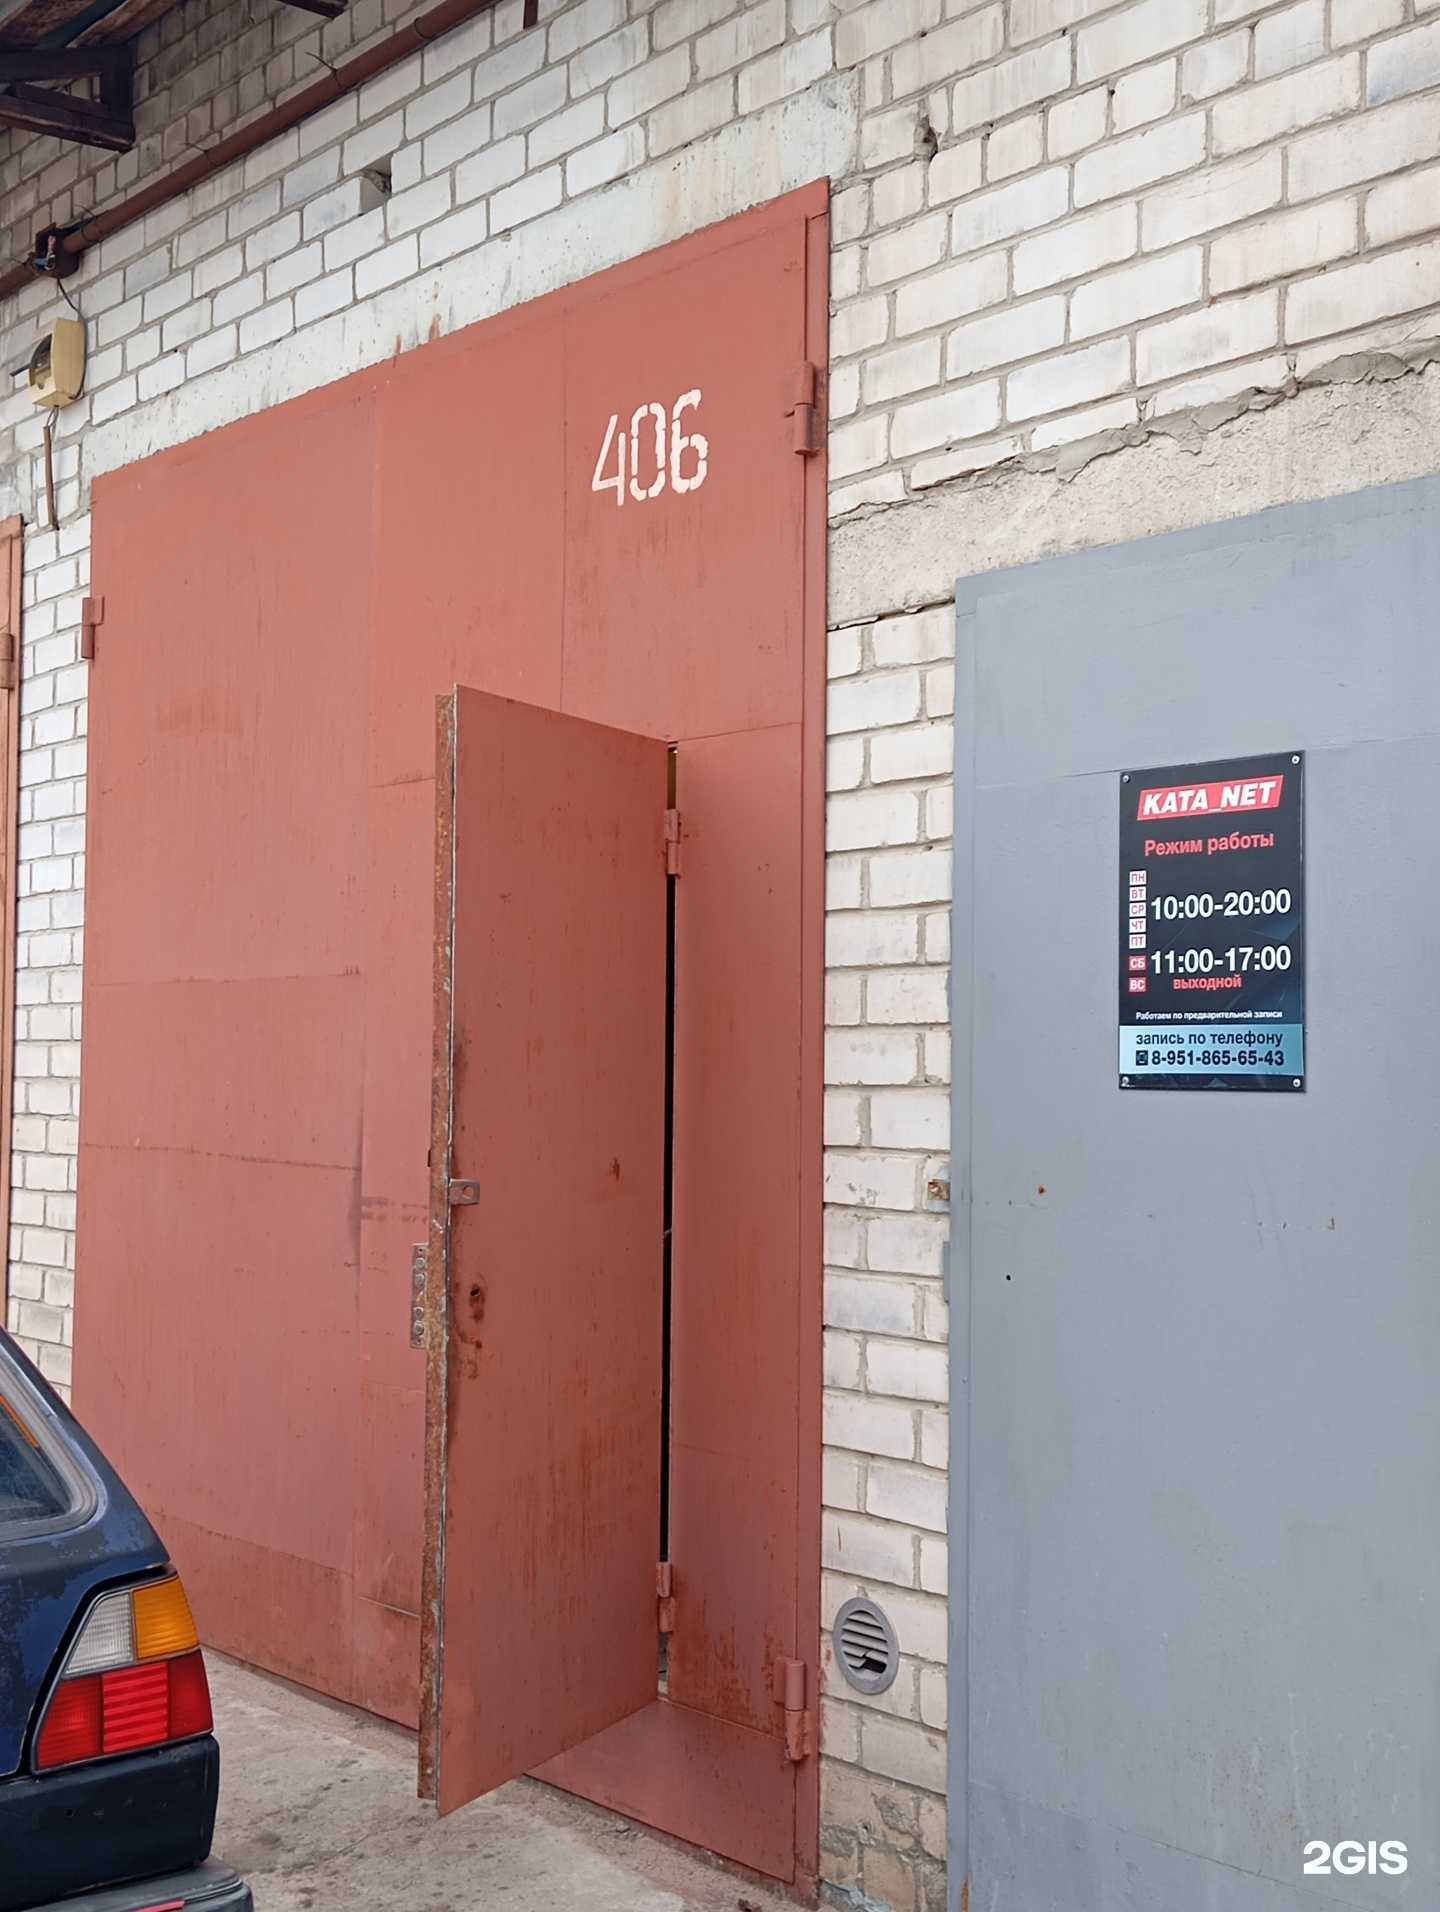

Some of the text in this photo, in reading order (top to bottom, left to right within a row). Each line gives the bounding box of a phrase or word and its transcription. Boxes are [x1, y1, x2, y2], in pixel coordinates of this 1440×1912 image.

[591, 388, 709, 506] 406
[1144, 832, 1274, 856] Режим работы
[1131, 873, 1145, 883] ПН
[1131, 888, 1144, 898] ВТ
[1131, 904, 1145, 914] СР
[1151, 889, 1291, 920] 10:00-20:00
[1131, 920, 1144, 930] ЧТ
[1131, 936, 1144, 946] ПТ
[1130, 957, 1146, 968] СБ
[1151, 945, 1292, 974] 11:00-17:00
[1130, 979, 1145, 990] ВС
[1135, 1011, 1171, 1020] Работаем
[1184, 1010, 1252, 1020] предварительной
[1254, 1011, 1282, 1019] записи
[1136, 1030, 1283, 1047] запись по телефону
[1151, 1050, 1285, 1066] 8-951-865-65-43
